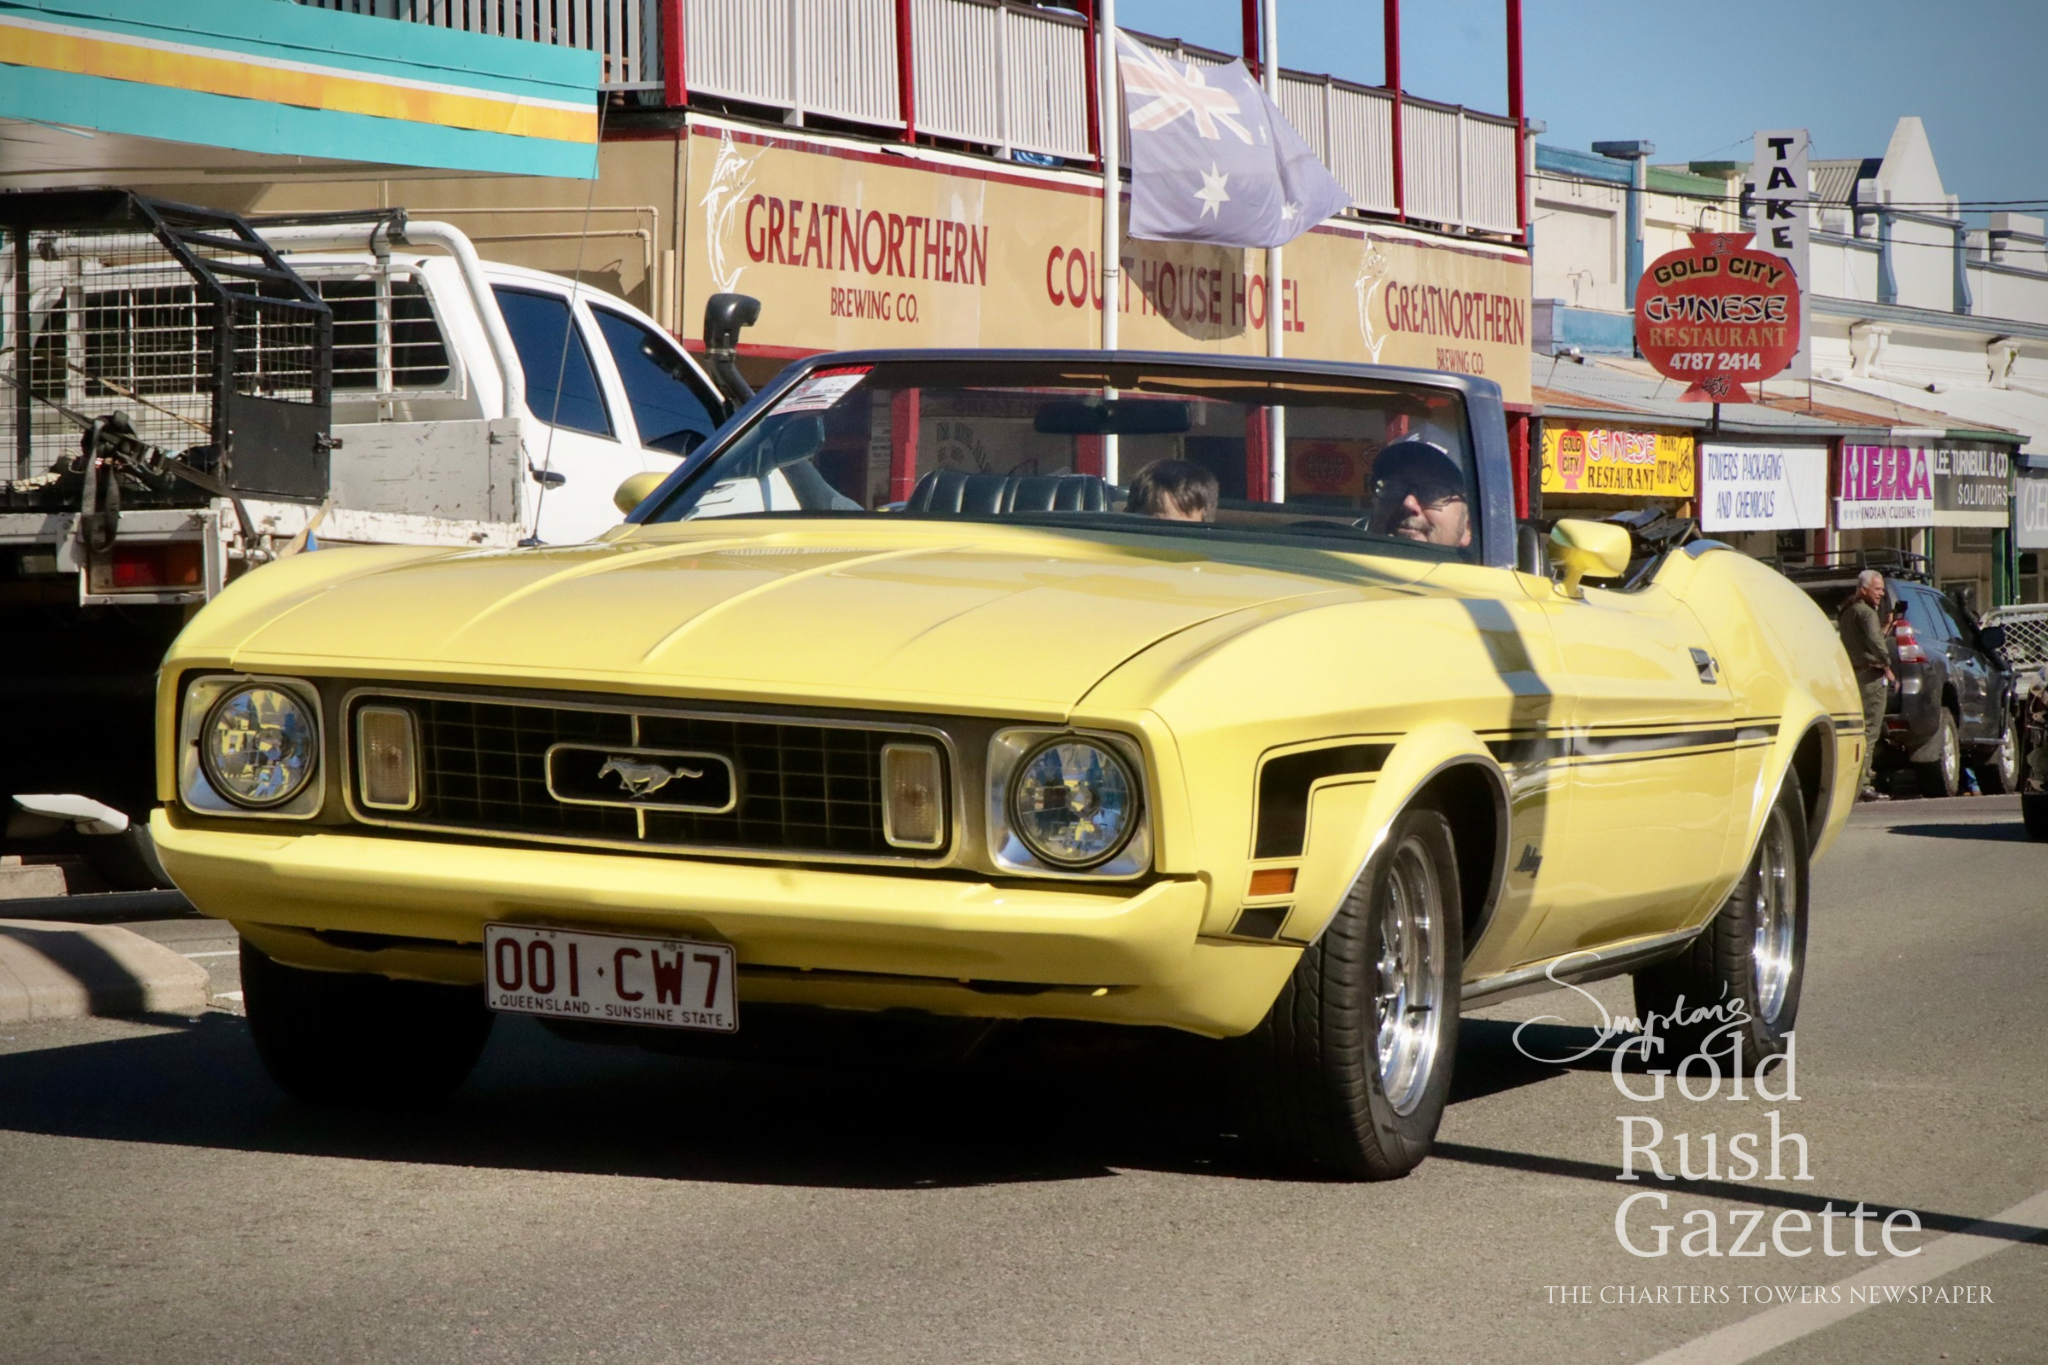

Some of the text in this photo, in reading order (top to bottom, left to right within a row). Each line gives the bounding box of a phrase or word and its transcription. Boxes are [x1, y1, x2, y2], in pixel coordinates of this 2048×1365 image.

[1654, 256, 1784, 286] GOLD CITY
[1047, 246, 1304, 333] COUT HOUSE HOEL
[831, 287, 919, 323] BREWING CO.
[1645, 295, 1788, 323] CHINESE
[1649, 327, 1788, 347] RESTAURANT
[1437, 348, 1485, 375] BREWING CO.
[1669, 353, 1761, 370] 4787 2414
[1562, 437, 1581, 452] GOLD
[1588, 428, 1656, 465] CHINESE
[1562, 456, 1580, 472] CITY
[1588, 466, 1655, 490] RESTAURANT
[1708, 452, 1738, 481] TOWERS
[1742, 453, 1782, 481] PACKAGING
[1842, 445, 1933, 501] HEERA
[1951, 450, 1989, 477] TURNBULL
[1996, 452, 2009, 478] CO
[1716, 490, 1775, 519] AND CHEMICALS
[1958, 483, 2008, 506] SOLICITORS
[1861, 505, 1916, 520] INDIAN CUISINE
[500, 994, 590, 1015] QUEENSLAND
[605, 1004, 674, 1022] SUNSHINE
[682, 1012, 723, 1028] STATE
